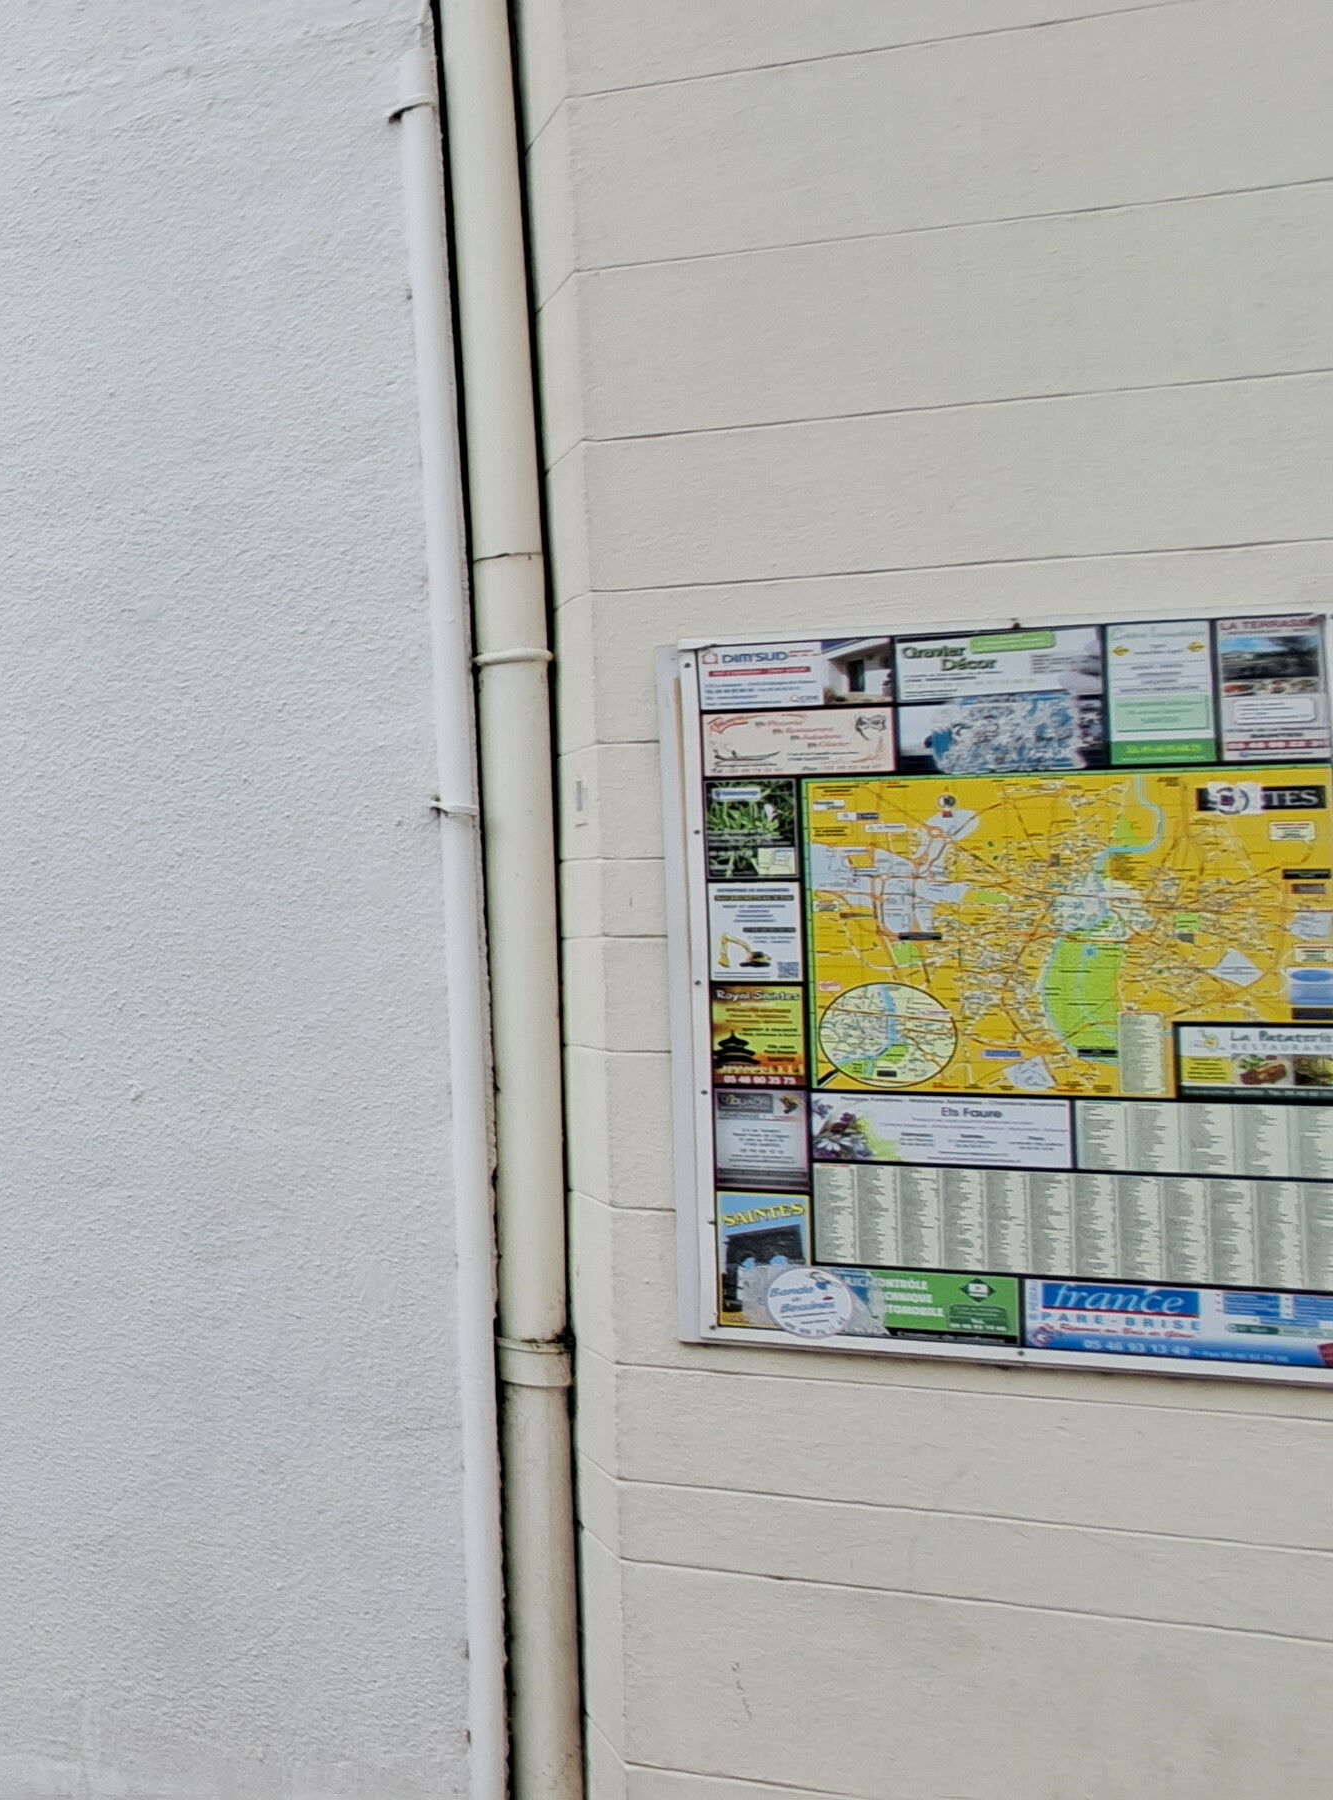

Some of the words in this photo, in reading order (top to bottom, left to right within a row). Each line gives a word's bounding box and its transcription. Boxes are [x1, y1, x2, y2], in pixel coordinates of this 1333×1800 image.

[941, 658, 998, 672] Décor
[716, 989, 750, 1003] Royal
[963, 1107, 1003, 1118] Faure
[722, 1203, 806, 1226] SAINTES
[1053, 1284, 1184, 1314] france
[1084, 1339, 1101, 1349] 05
